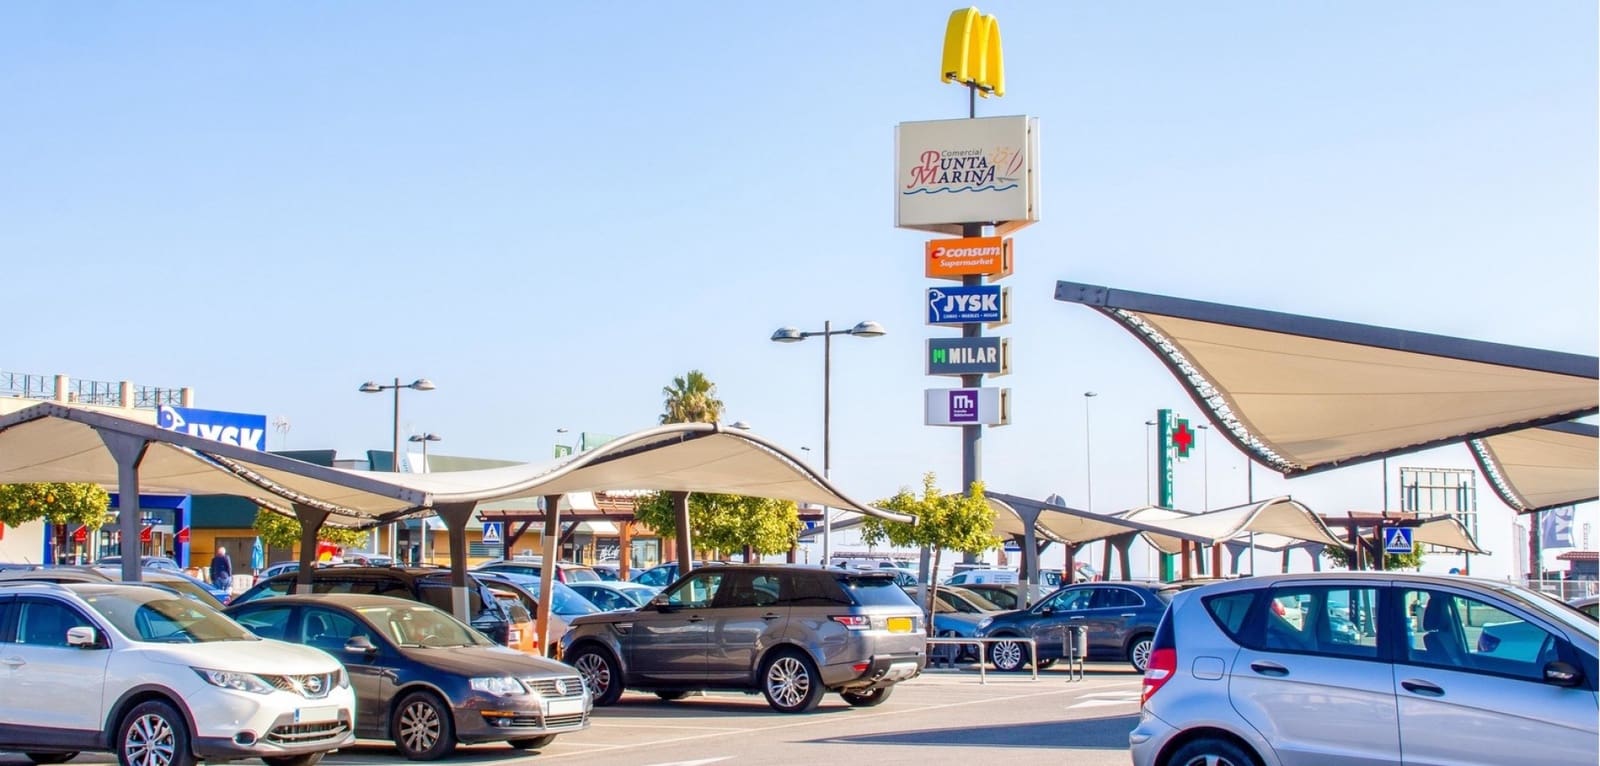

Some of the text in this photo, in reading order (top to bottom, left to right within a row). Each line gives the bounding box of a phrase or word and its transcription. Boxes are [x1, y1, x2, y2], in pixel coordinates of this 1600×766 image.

[920, 150, 988, 171] PUNTA
[941, 149, 983, 157] Comercial
[907, 165, 996, 189] MARINA
[946, 246, 1000, 258] consum
[940, 258, 994, 268] Supermarket
[943, 294, 998, 312] JYSK
[949, 347, 997, 364] MILAR
